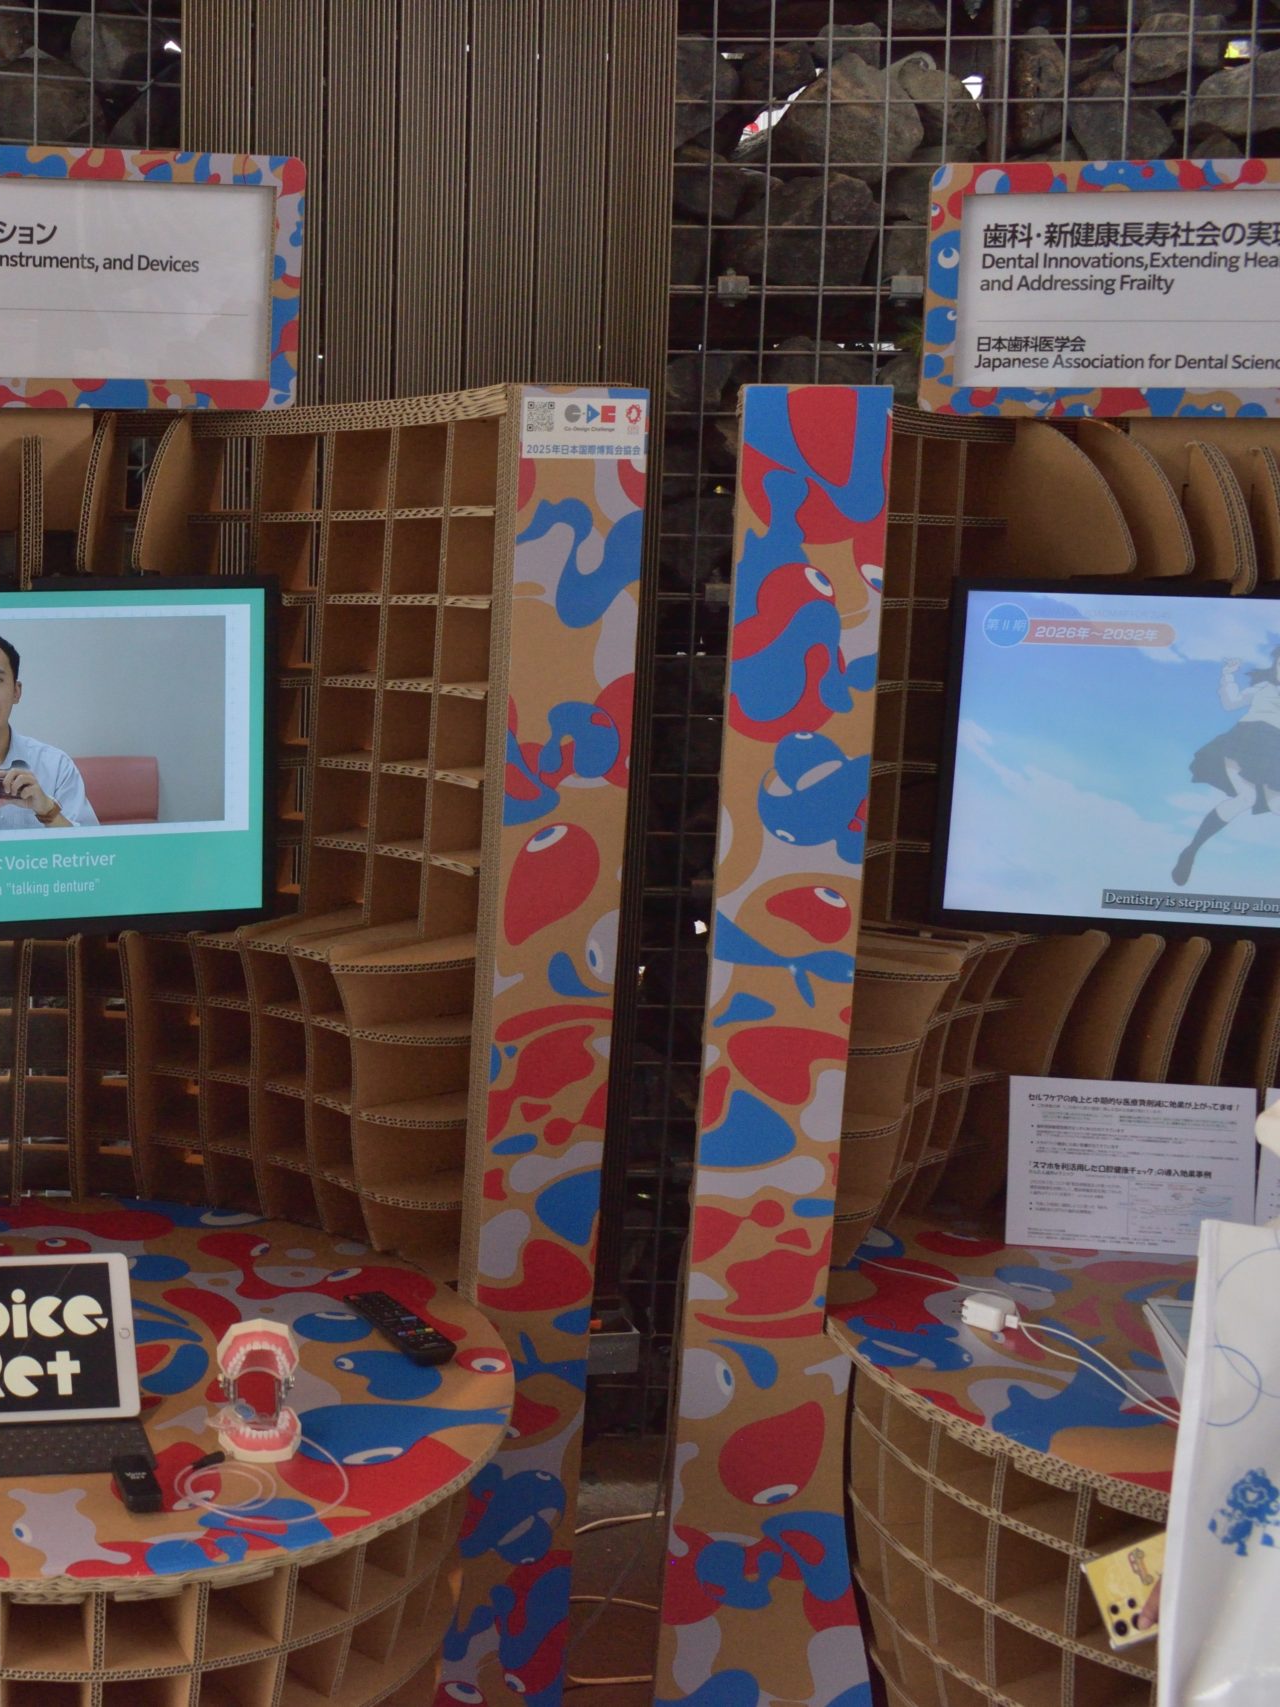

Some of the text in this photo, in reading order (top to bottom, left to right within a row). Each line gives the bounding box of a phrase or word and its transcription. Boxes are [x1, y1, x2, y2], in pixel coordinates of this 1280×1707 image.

[103, 254, 133, 271] and
[138, 255, 199, 272] Devices
[982, 252, 1038, 269] Dental
[1244, 252, 1280, 268] Hea
[980, 275, 1175, 295] and Addressing Frailty
[977, 336, 1086, 352] 日本歯科医学会
[974, 354, 1049, 372] Japanese
[1052, 354, 1145, 369] Association
[1148, 354, 1172, 369] for
[1175, 354, 1228, 370] Dental
[52, 852, 116, 868] Retriver
[1105, 892, 1280, 914] Dentistry is stepping up alon
